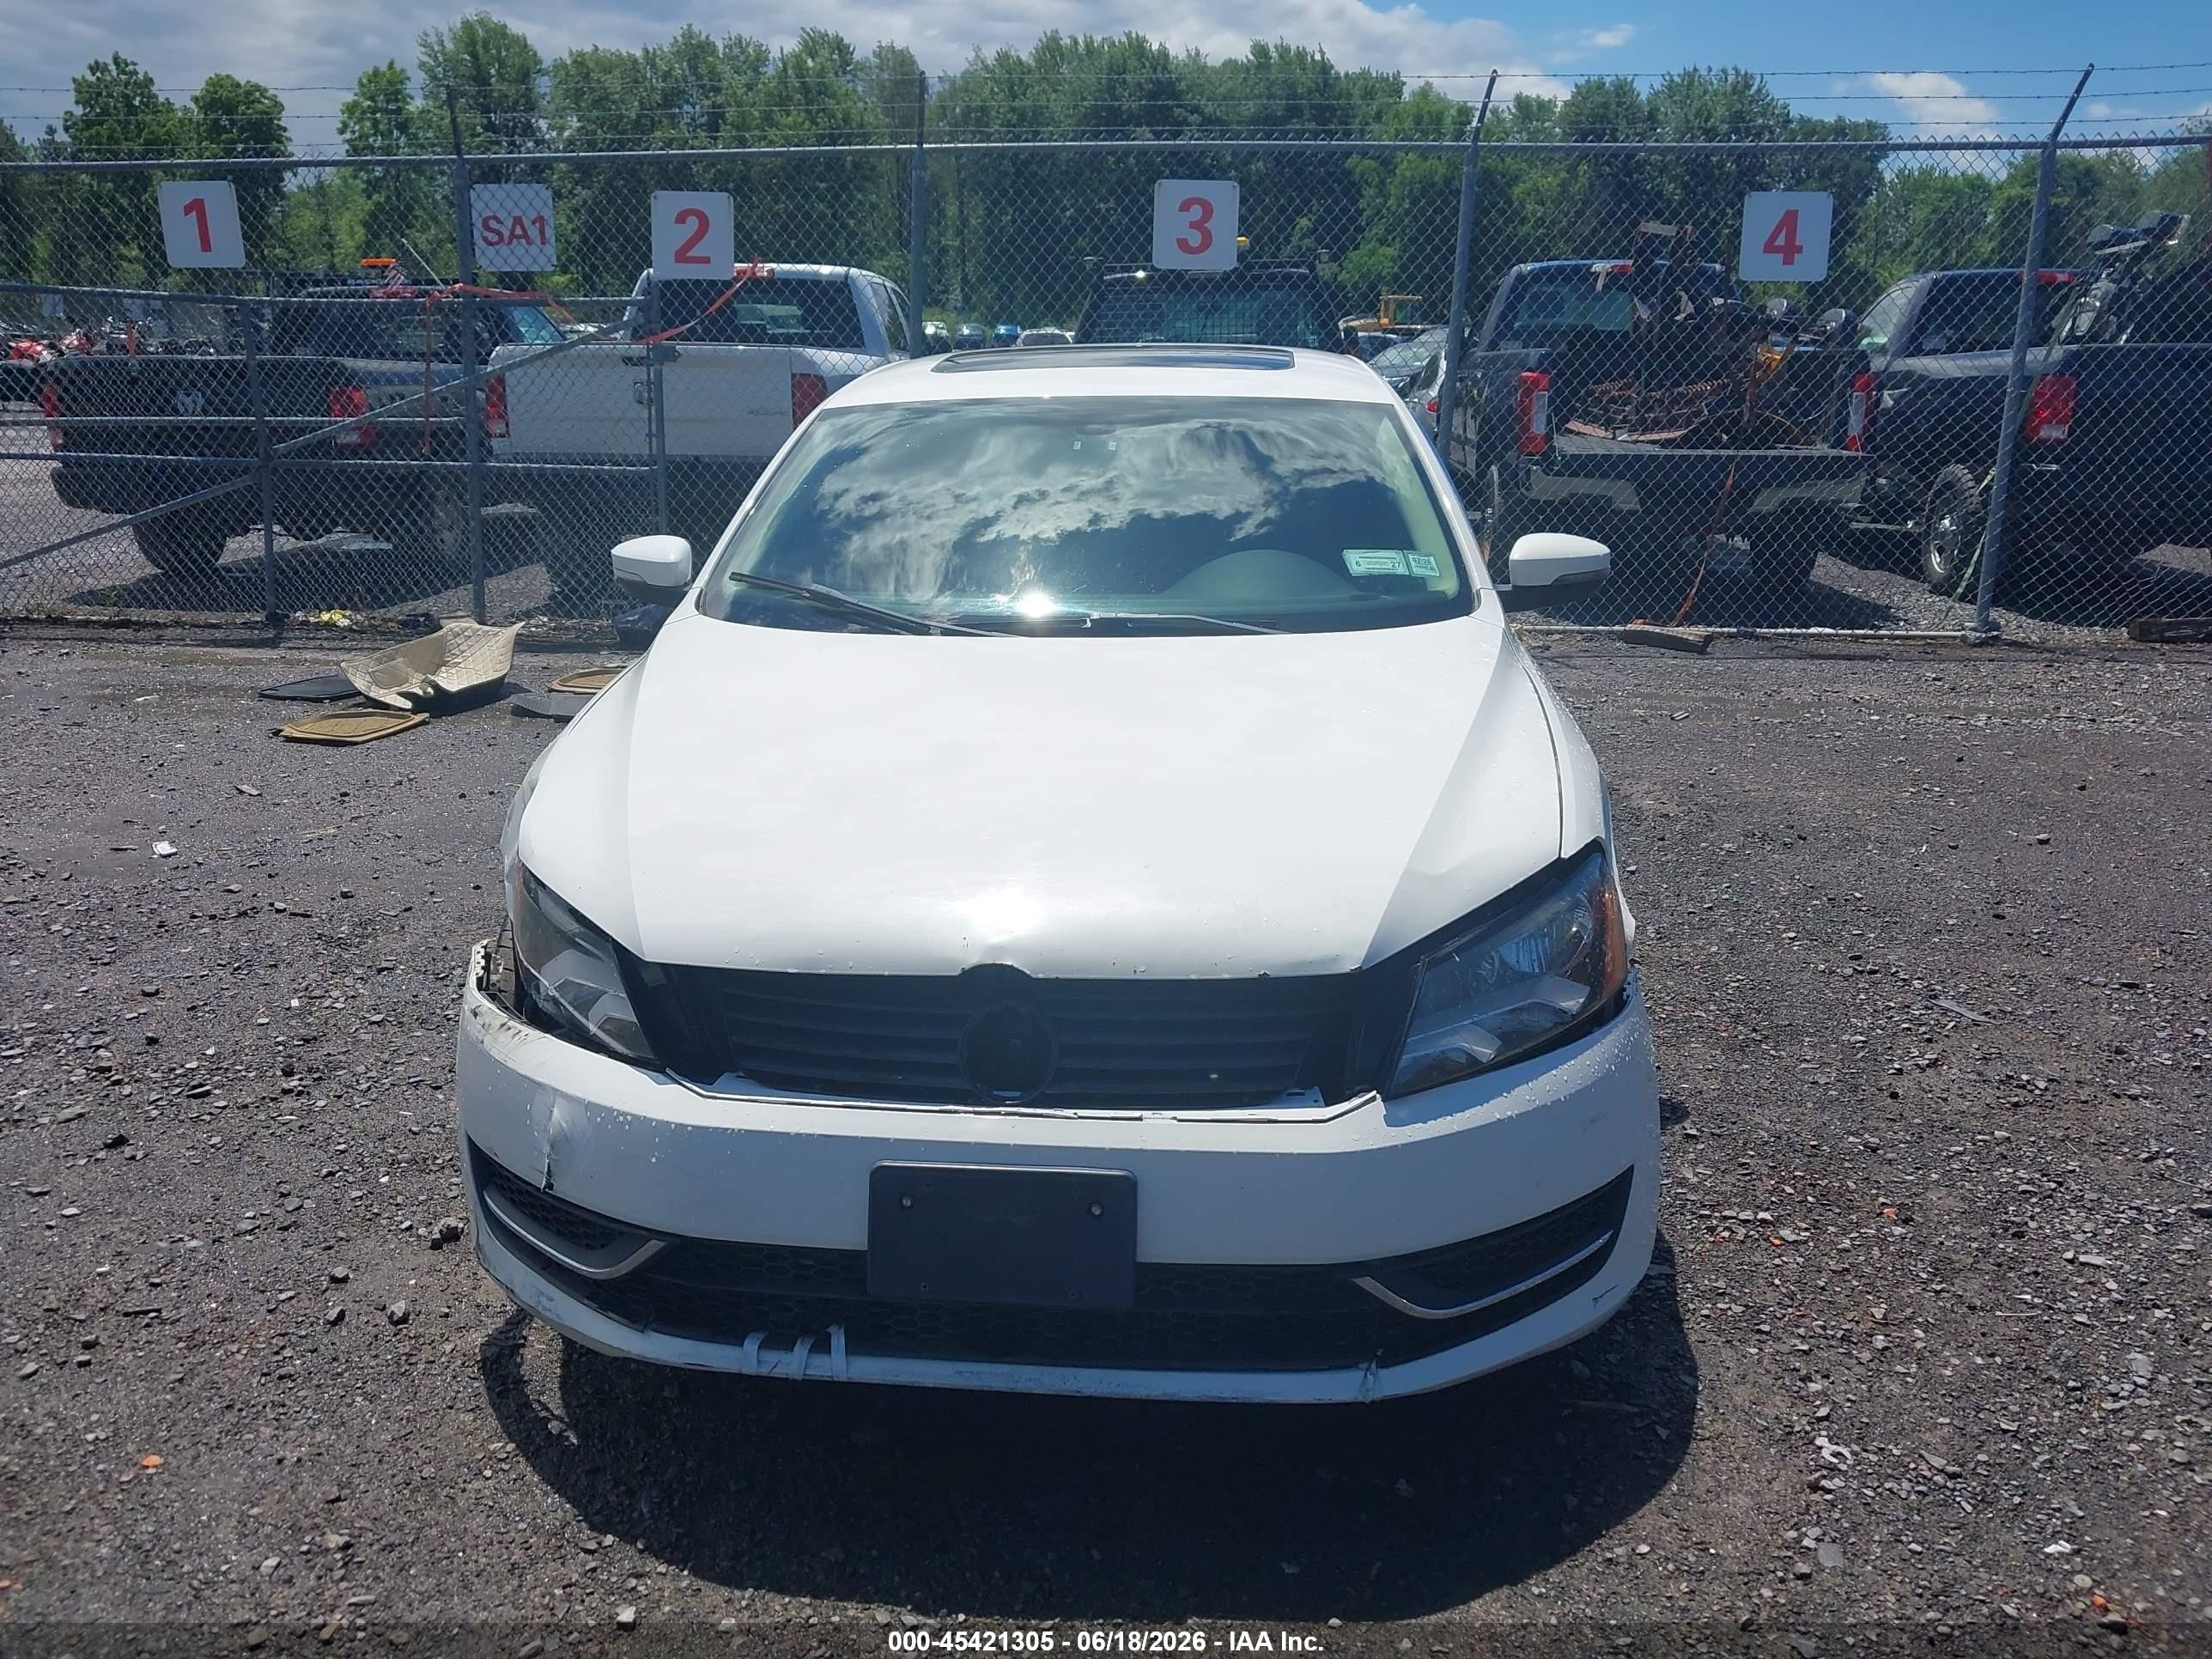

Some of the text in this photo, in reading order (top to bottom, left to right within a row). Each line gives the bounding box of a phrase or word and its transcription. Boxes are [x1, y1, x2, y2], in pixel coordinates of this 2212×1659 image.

[183, 198, 213, 253] 1
[483, 215, 547, 246] SA1
[674, 208, 711, 264] 2
[1176, 197, 1213, 255] 3
[1763, 209, 1803, 265] 4
